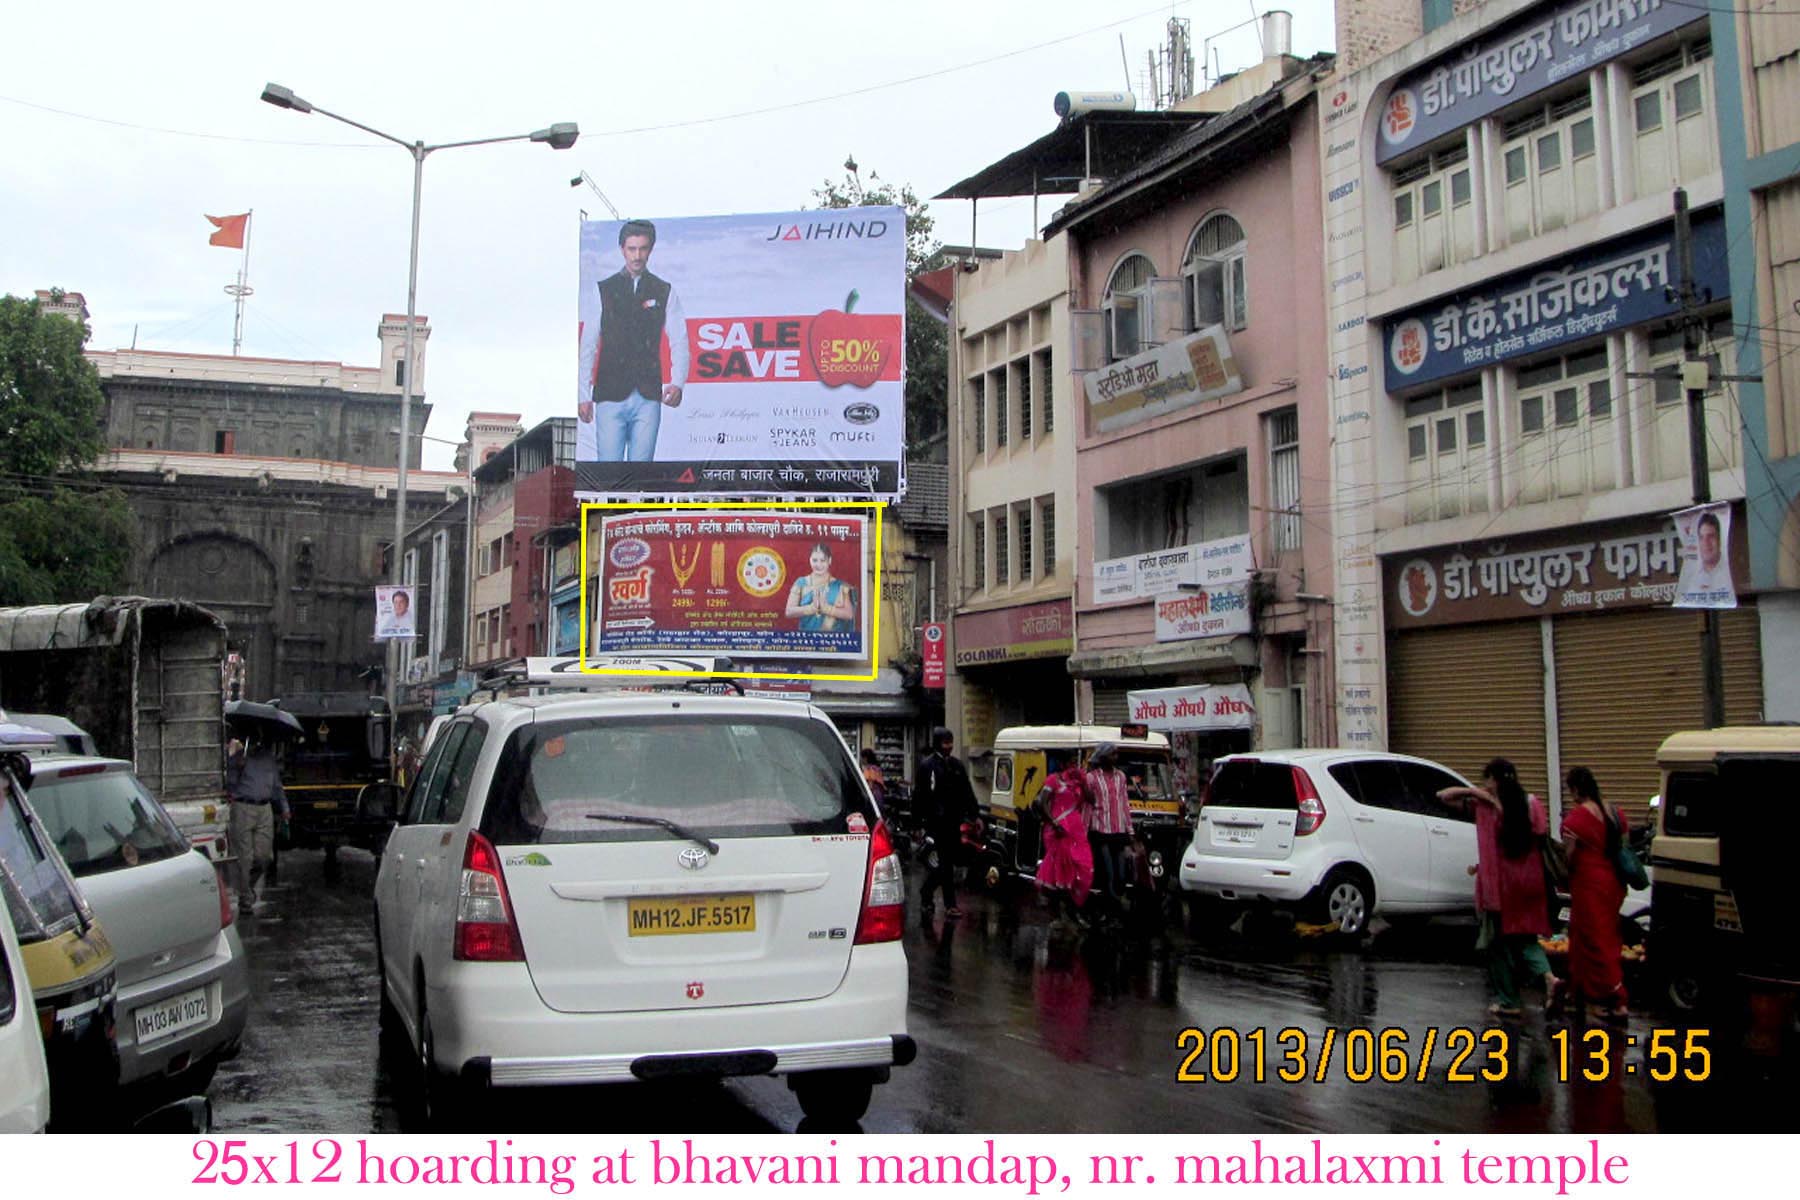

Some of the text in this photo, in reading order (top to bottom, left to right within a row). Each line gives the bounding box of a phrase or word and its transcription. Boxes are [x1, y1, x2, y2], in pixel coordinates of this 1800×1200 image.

[767, 221, 887, 241] JAIHIND
[697, 321, 800, 350] SALE
[696, 350, 800, 378] SAVE
[830, 364, 879, 373] DISCOUNT
[770, 428, 817, 438] SPYKAR
[779, 438, 817, 447] JEANS
[703, 468, 736, 482] जनता
[740, 468, 774, 482] बाजार
[779, 465, 809, 483] चौक,
[611, 569, 649, 600] स्वर्ग
[1158, 591, 1209, 626] महालक्ष्मी
[1594, 588, 1626, 609] दुकान
[957, 647, 1008, 664] SOLANKI
[1134, 700, 1167, 720] औषधे
[1172, 697, 1206, 718] औषधे
[633, 906, 751, 929] MH12.JF.5517
[183, 1000, 207, 1021] 1072
